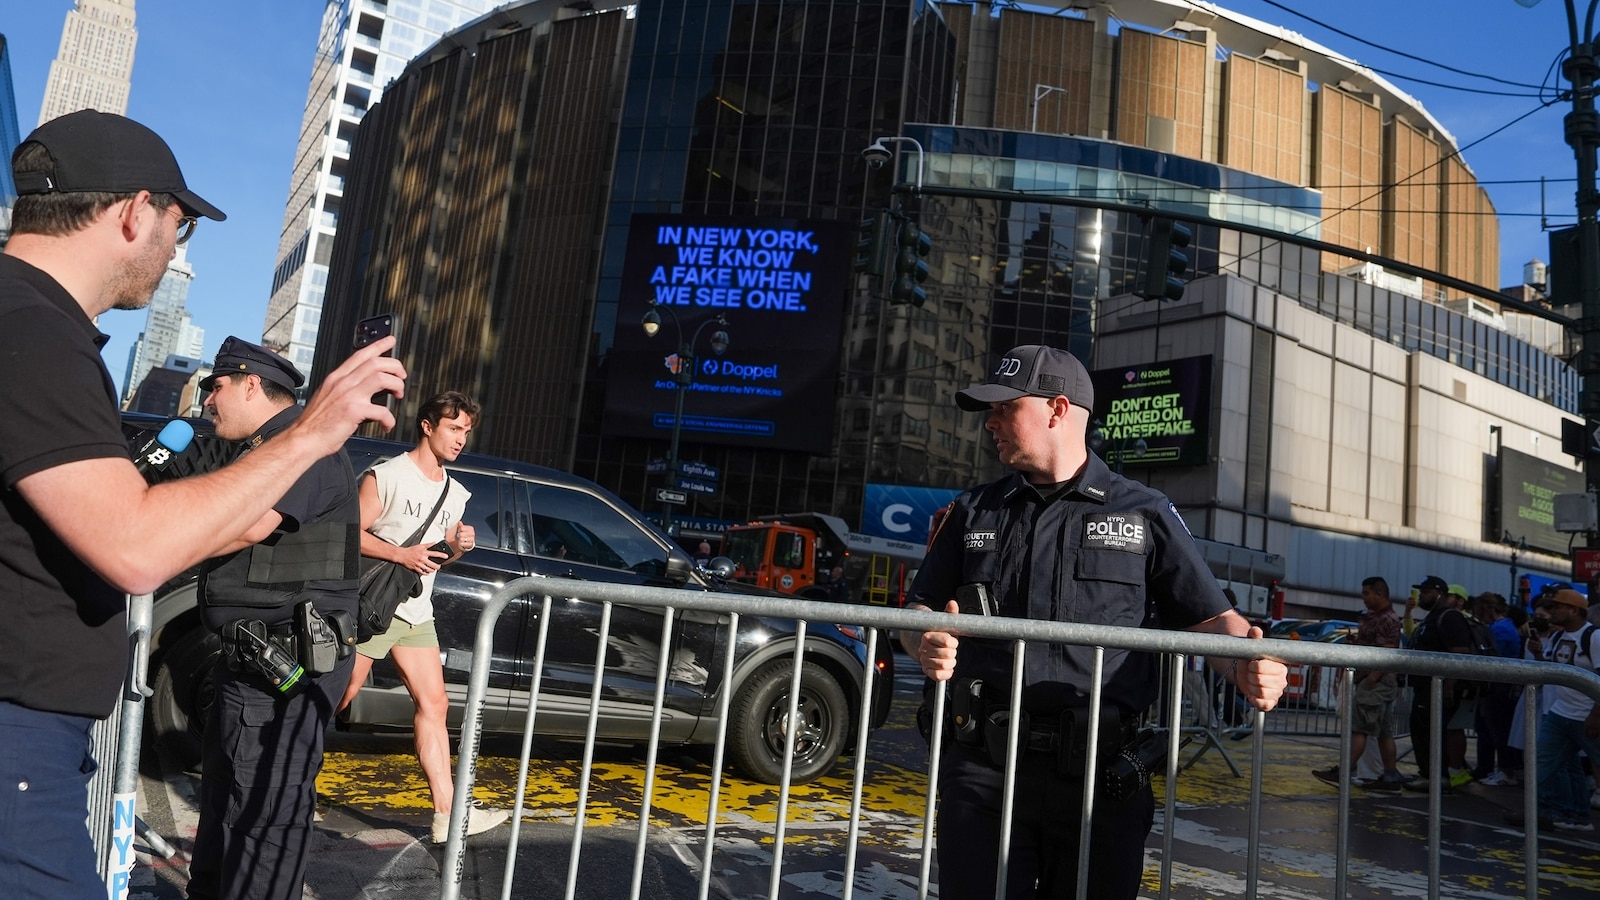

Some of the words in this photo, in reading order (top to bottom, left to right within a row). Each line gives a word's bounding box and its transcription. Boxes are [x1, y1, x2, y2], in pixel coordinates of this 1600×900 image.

[658, 226, 682, 244] IN
[686, 228, 741, 246] NEW
[746, 229, 819, 254] YORK,
[678, 247, 713, 265] WE
[718, 248, 794, 269] KNOW
[651, 266, 667, 284] A
[671, 266, 732, 286] FAKE
[738, 269, 811, 291] WHEN
[656, 286, 691, 305] WE
[695, 287, 742, 307] SEE
[747, 290, 806, 311] ONE.
[722, 361, 778, 380] Doppel
[1148, 368, 1170, 379] Doppel
[692, 382, 720, 393] Partner
[1111, 397, 1151, 413] DON'T
[1152, 393, 1180, 409] GET
[1106, 410, 1160, 427] DUNKED
[1162, 407, 1183, 421] ON
[1112, 427, 1121, 439] A
[683, 464, 703, 475] Eighth
[703, 468, 715, 477] Ave
[681, 481, 690, 489] Joe
[691, 482, 704, 492] Louis
[1087, 521, 1143, 539] POLICE
[886, 540, 914, 551] sanitation
[966, 539, 984, 548] 2270
[1088, 534, 1141, 545] COUNTERTERRORISM
